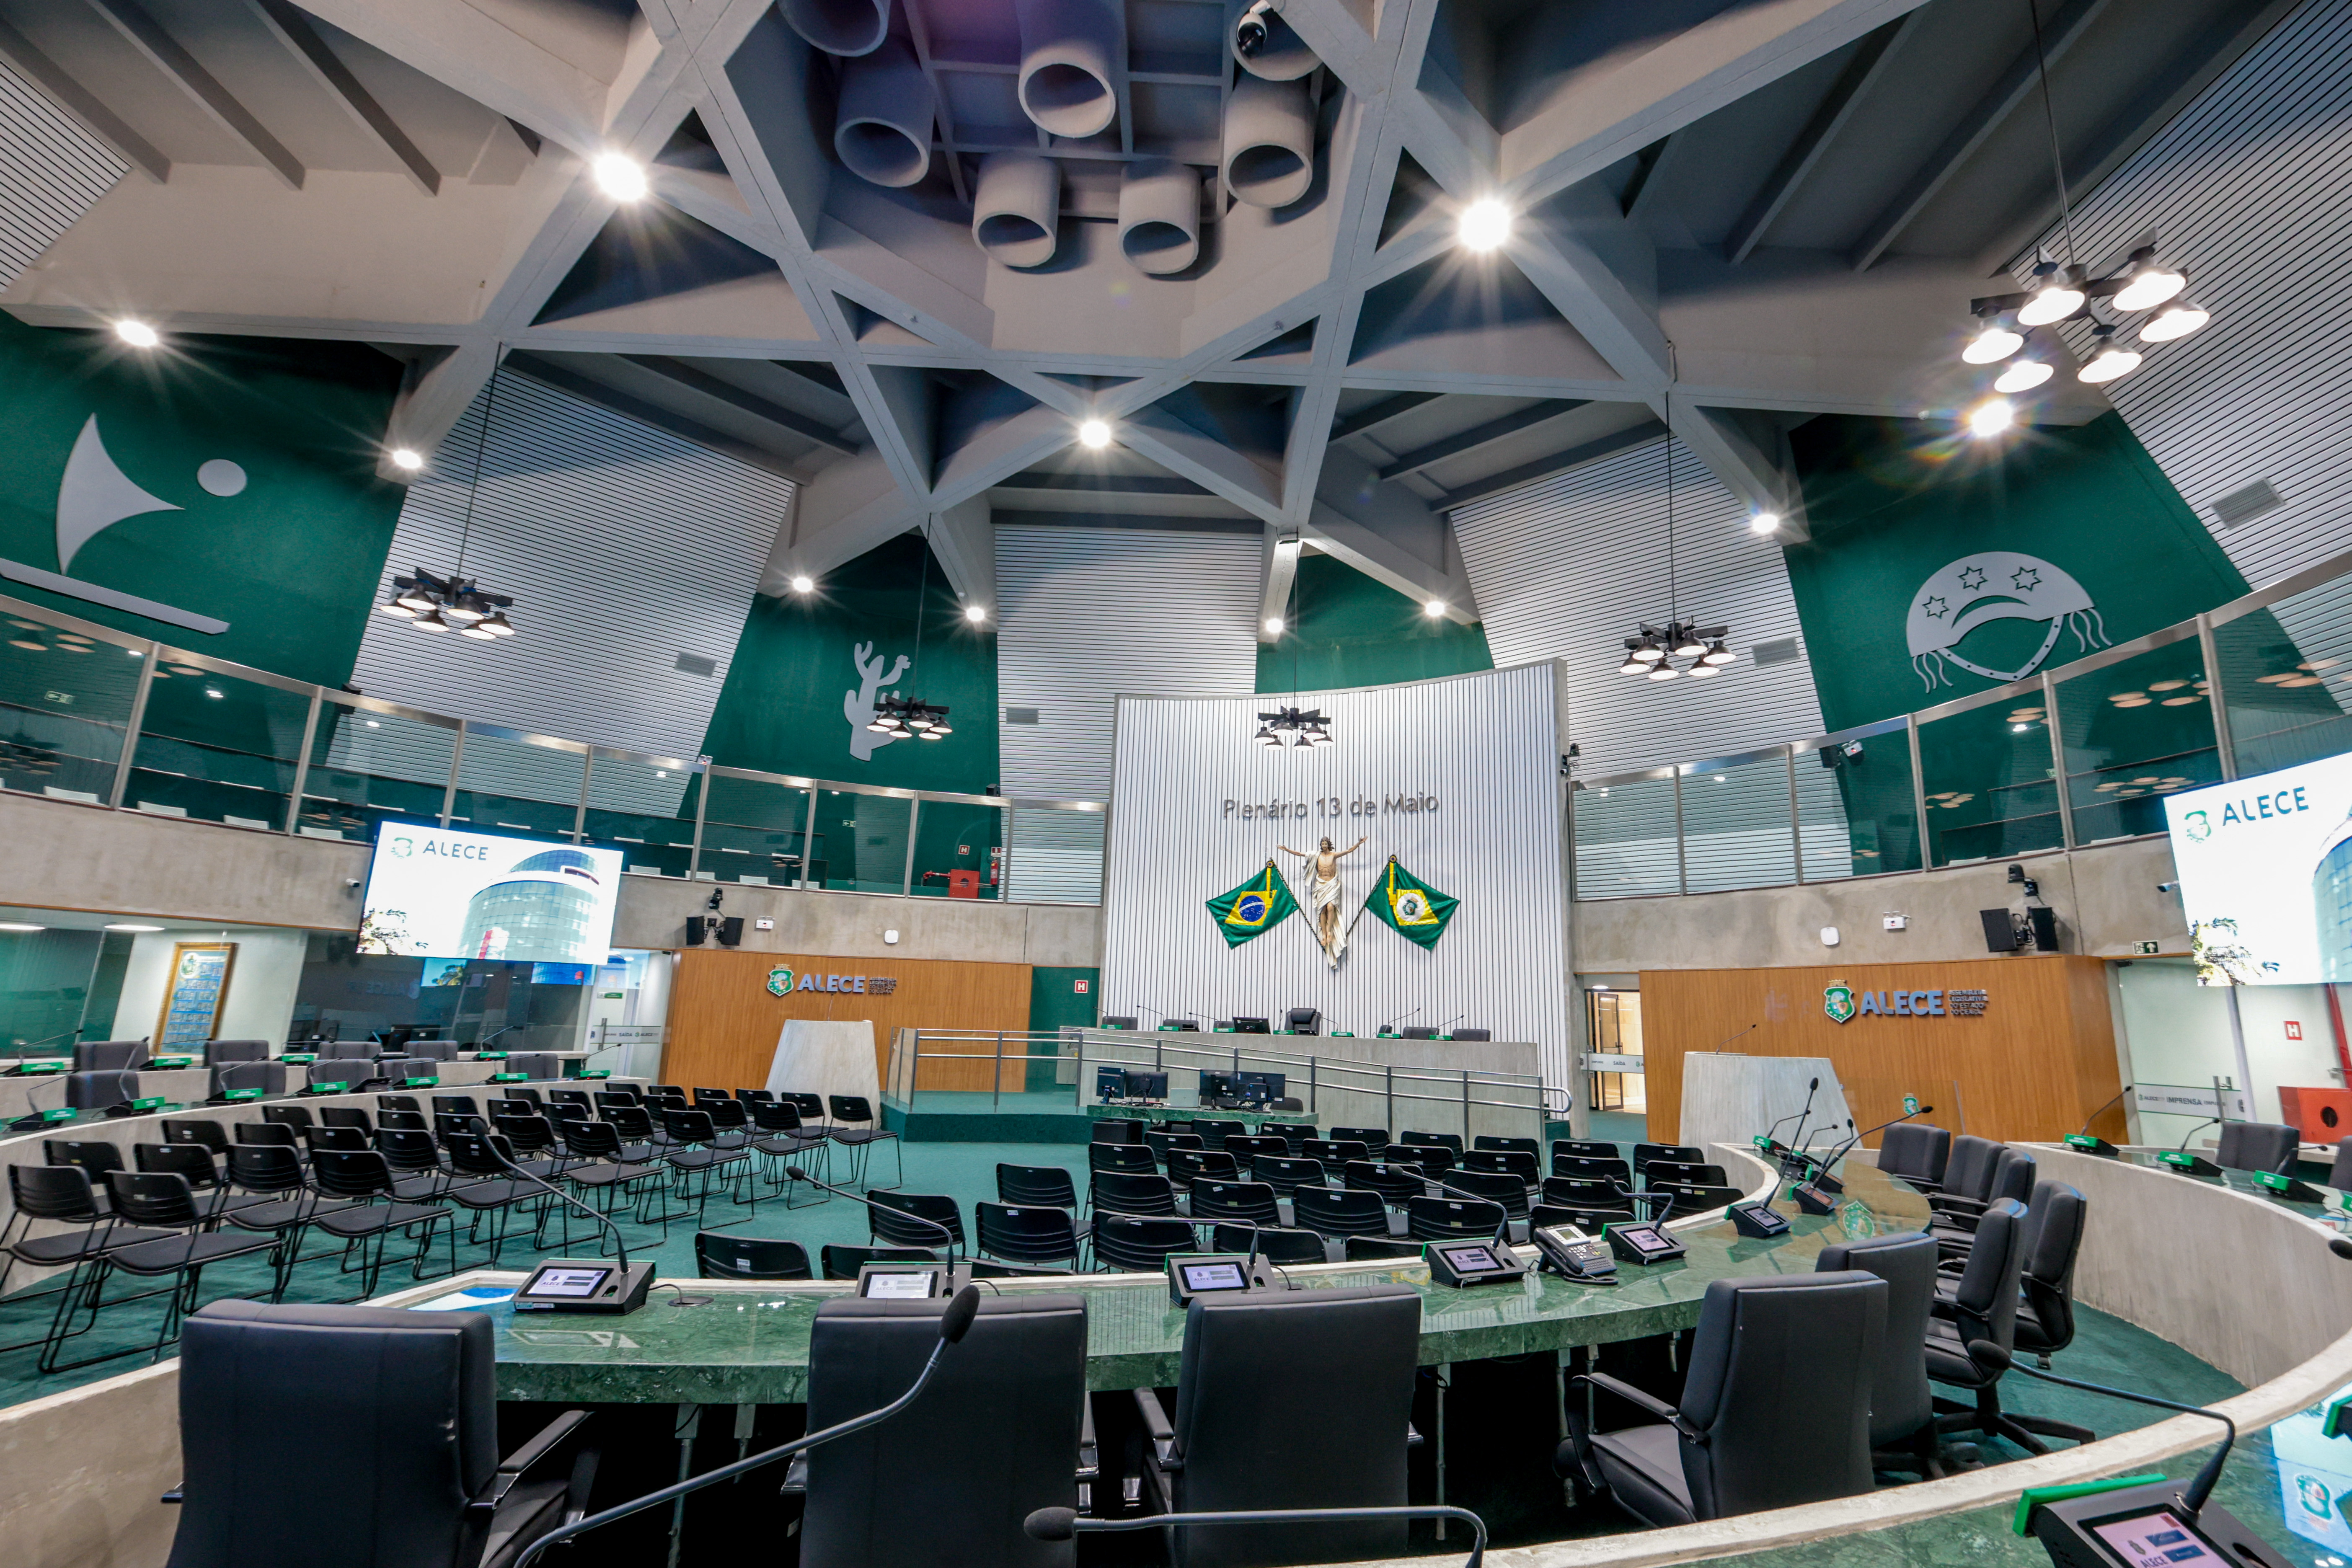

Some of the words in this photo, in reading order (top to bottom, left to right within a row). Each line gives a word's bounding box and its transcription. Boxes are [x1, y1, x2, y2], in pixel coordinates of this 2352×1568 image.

[1223, 798, 1308, 819] Plenário
[1316, 797, 1341, 816] 13
[1349, 794, 1376, 816] de
[1383, 791, 1439, 814] Maio
[2222, 786, 2309, 826] ALECE
[422, 840, 488, 861] ALECE
[796, 974, 866, 993] ALECE
[1860, 990, 1946, 1015] ALECE
[2287, 1024, 2300, 1037] H
[2166, 1096, 2202, 1106] IMPRENSA
[2140, 1555, 2168, 1568] ALECE
